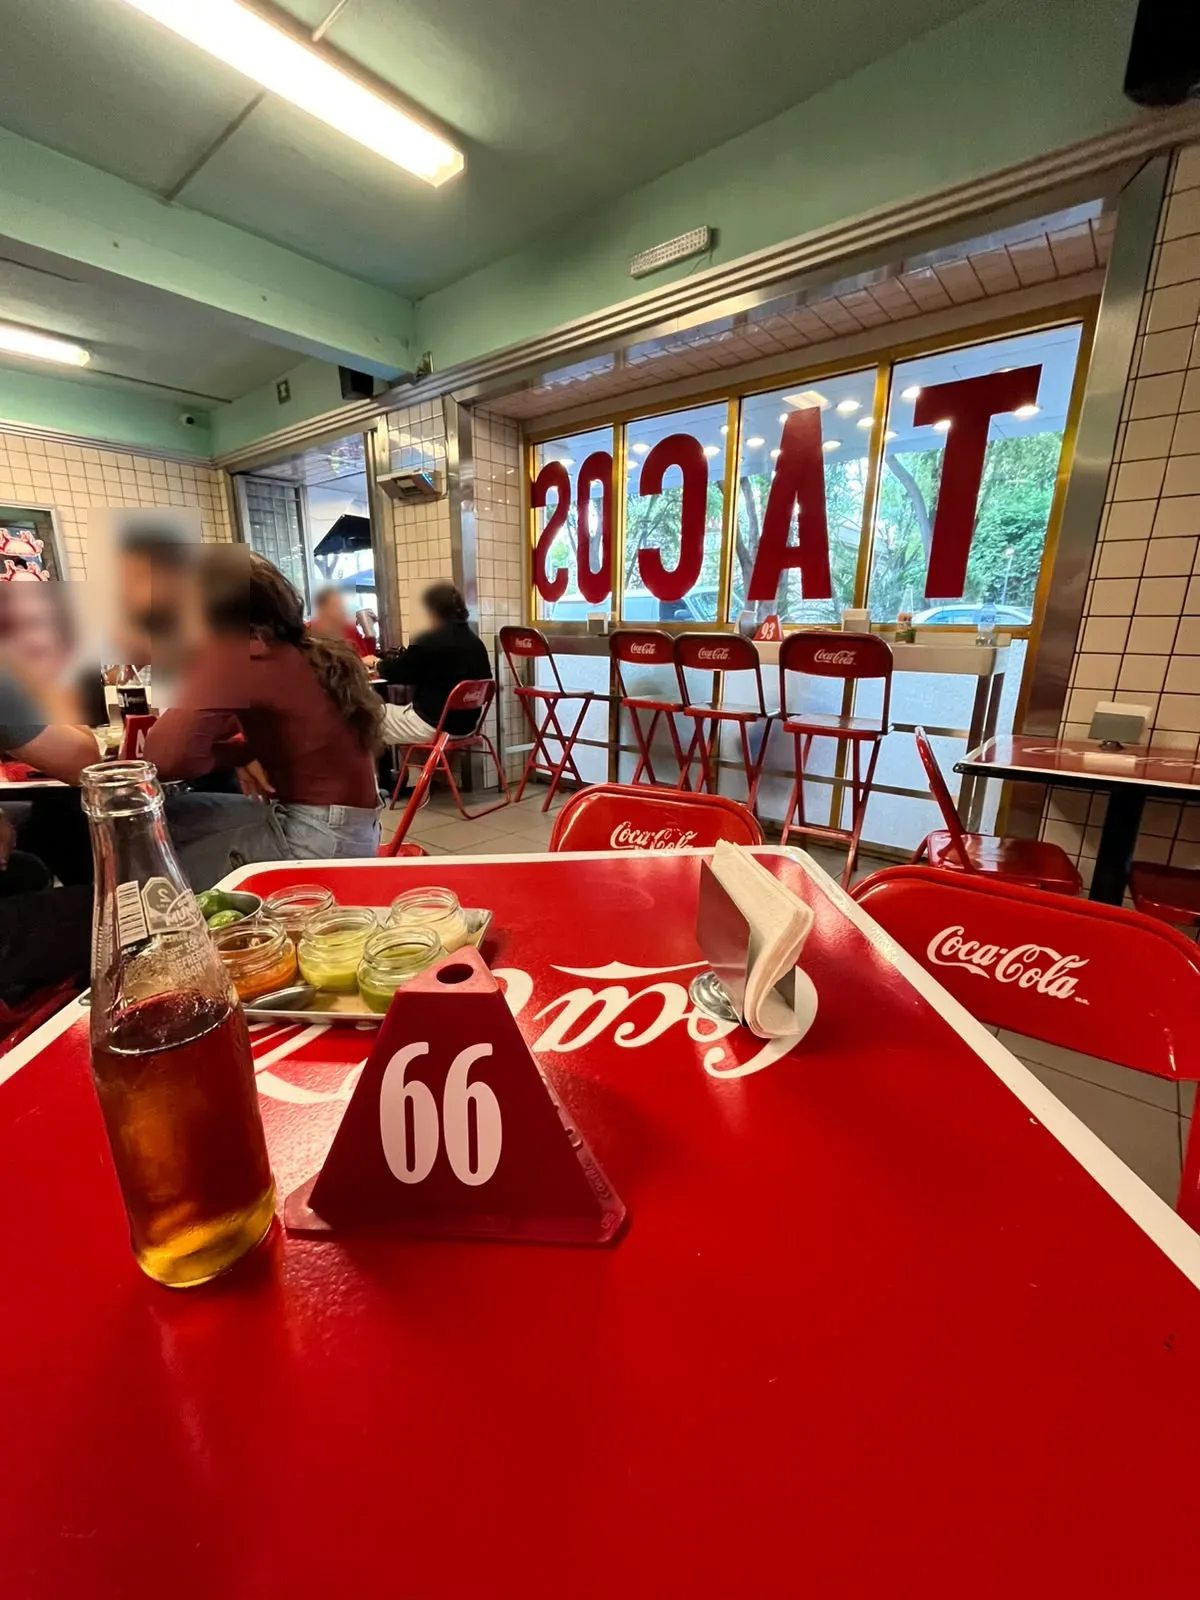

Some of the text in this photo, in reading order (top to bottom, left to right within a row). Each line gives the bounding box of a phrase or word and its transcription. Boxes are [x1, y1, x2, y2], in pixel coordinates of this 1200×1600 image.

[760, 622, 776, 640] 93
[926, 925, 1090, 1000] Coca-Cola
[379, 1041, 503, 1187] 66
